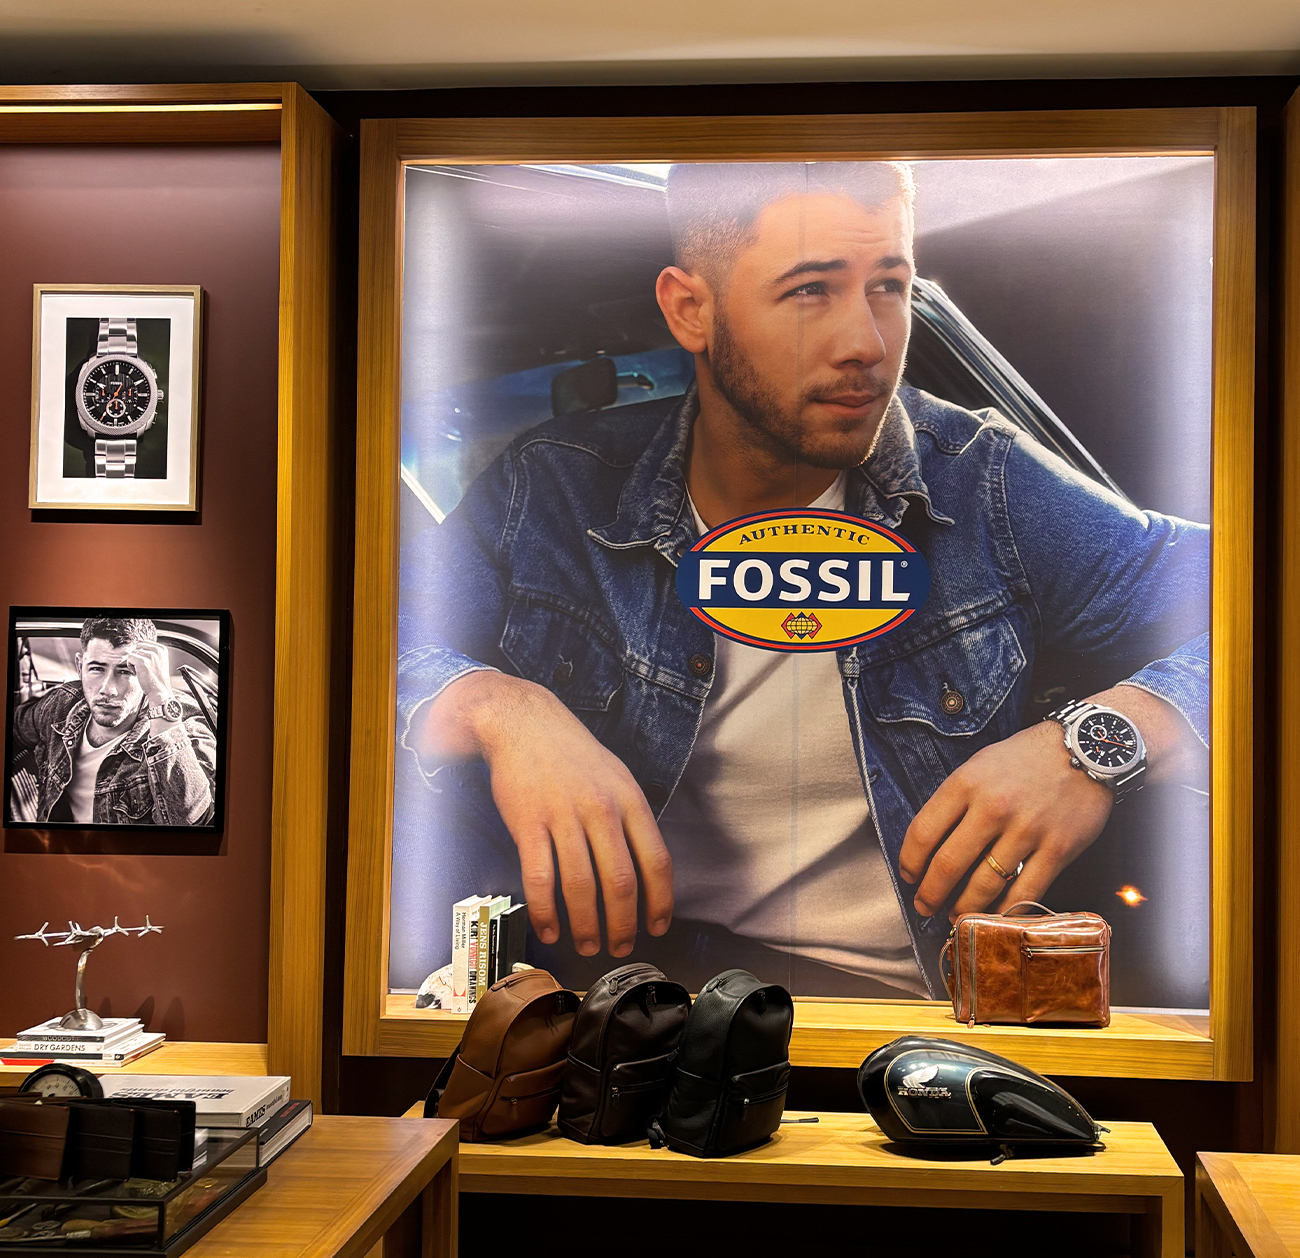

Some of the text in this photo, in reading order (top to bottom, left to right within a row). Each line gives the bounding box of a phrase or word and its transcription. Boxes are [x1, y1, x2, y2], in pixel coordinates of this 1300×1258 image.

[738, 523, 870, 546] AUTHENTIC
[479, 922, 487, 986] JENS RISOM
[50, 1044, 86, 1052] GARDENS
[898, 1086, 952, 1099] HONDA
